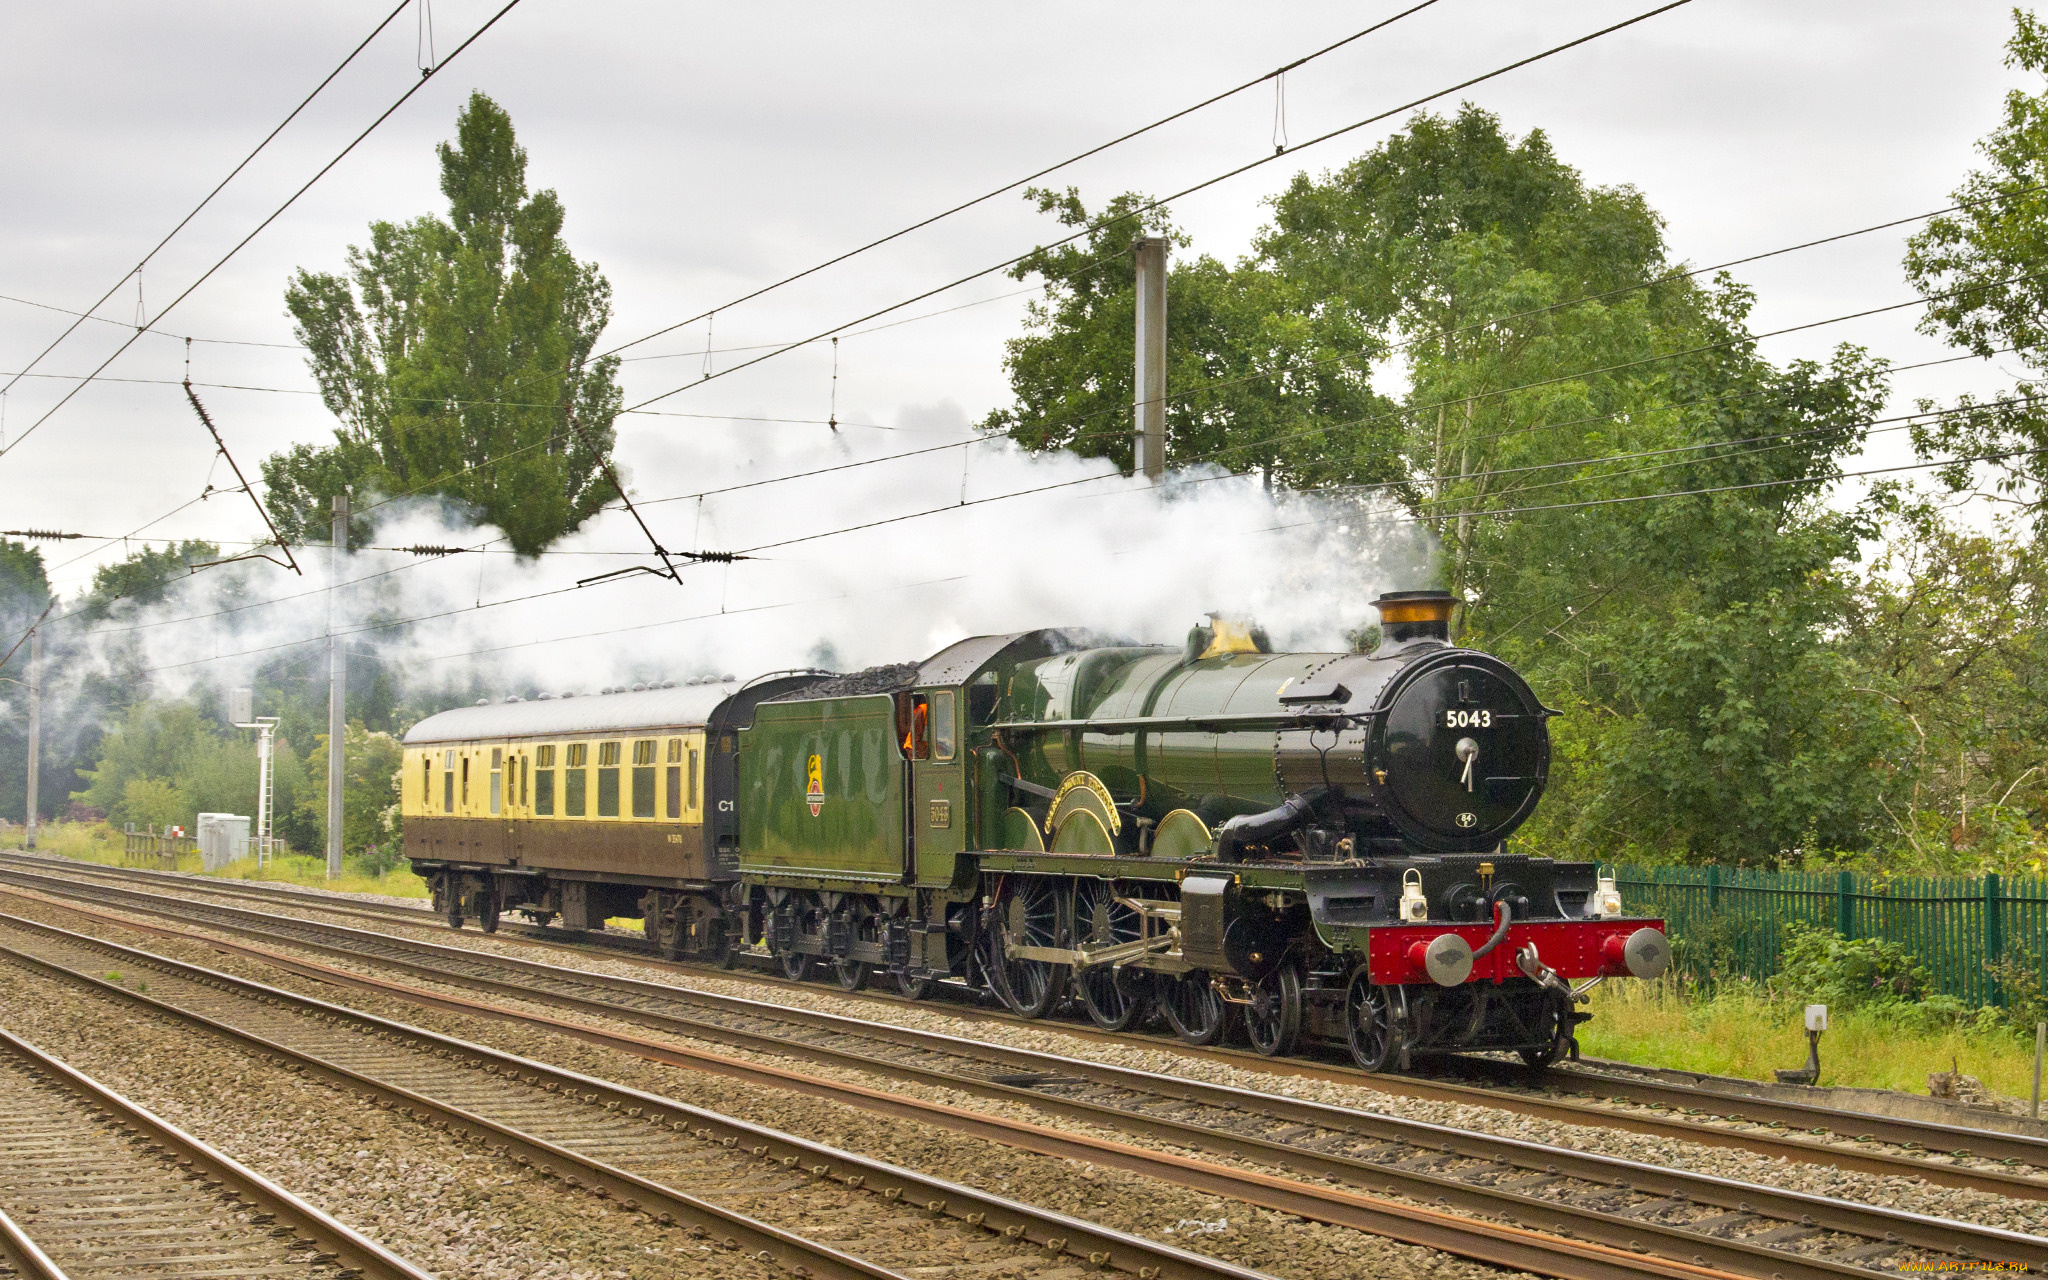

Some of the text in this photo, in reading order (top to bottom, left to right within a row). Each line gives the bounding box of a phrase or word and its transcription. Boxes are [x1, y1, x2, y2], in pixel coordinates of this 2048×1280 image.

[1446, 710, 1491, 728] 5043
[718, 800, 734, 812] C1
[930, 806, 949, 822] 5043
